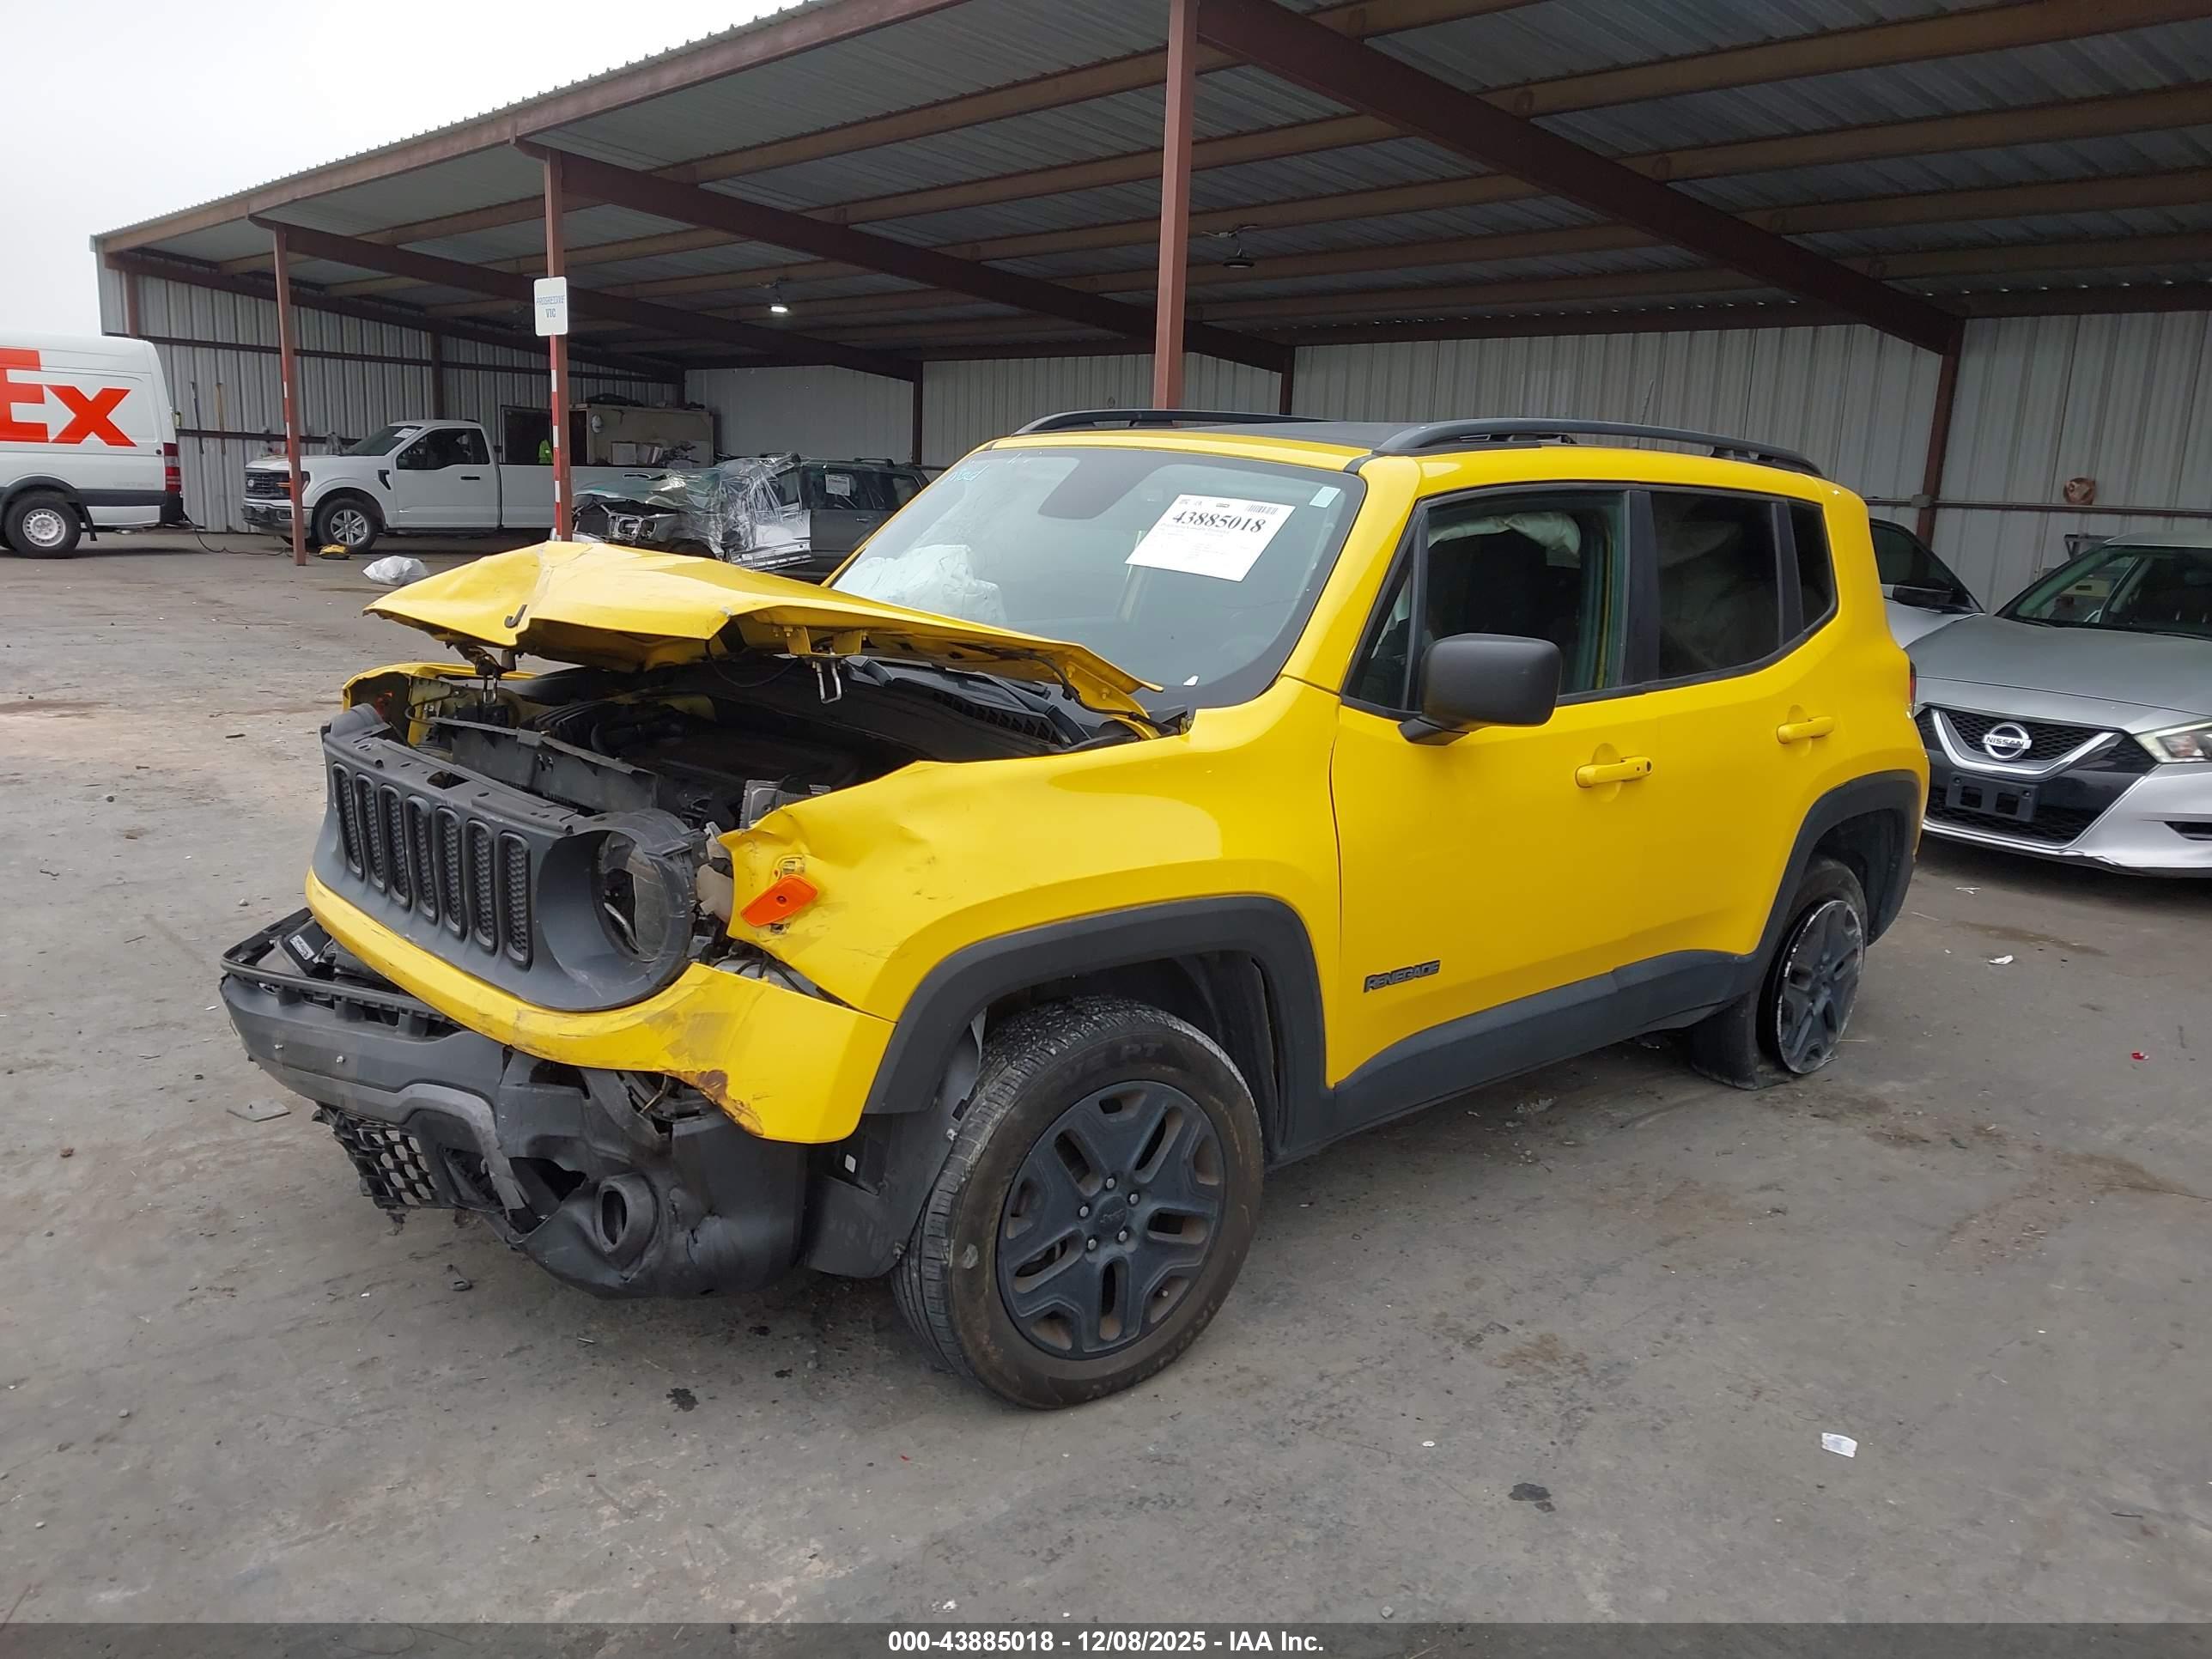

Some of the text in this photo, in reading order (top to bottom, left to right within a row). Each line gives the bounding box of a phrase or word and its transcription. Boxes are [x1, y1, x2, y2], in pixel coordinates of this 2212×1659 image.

[545, 307, 556, 319] VIC
[1172, 511, 1266, 533] 43885018
[1985, 736, 2025, 747] NISSAN
[1364, 959, 1441, 994] RENEGADE
